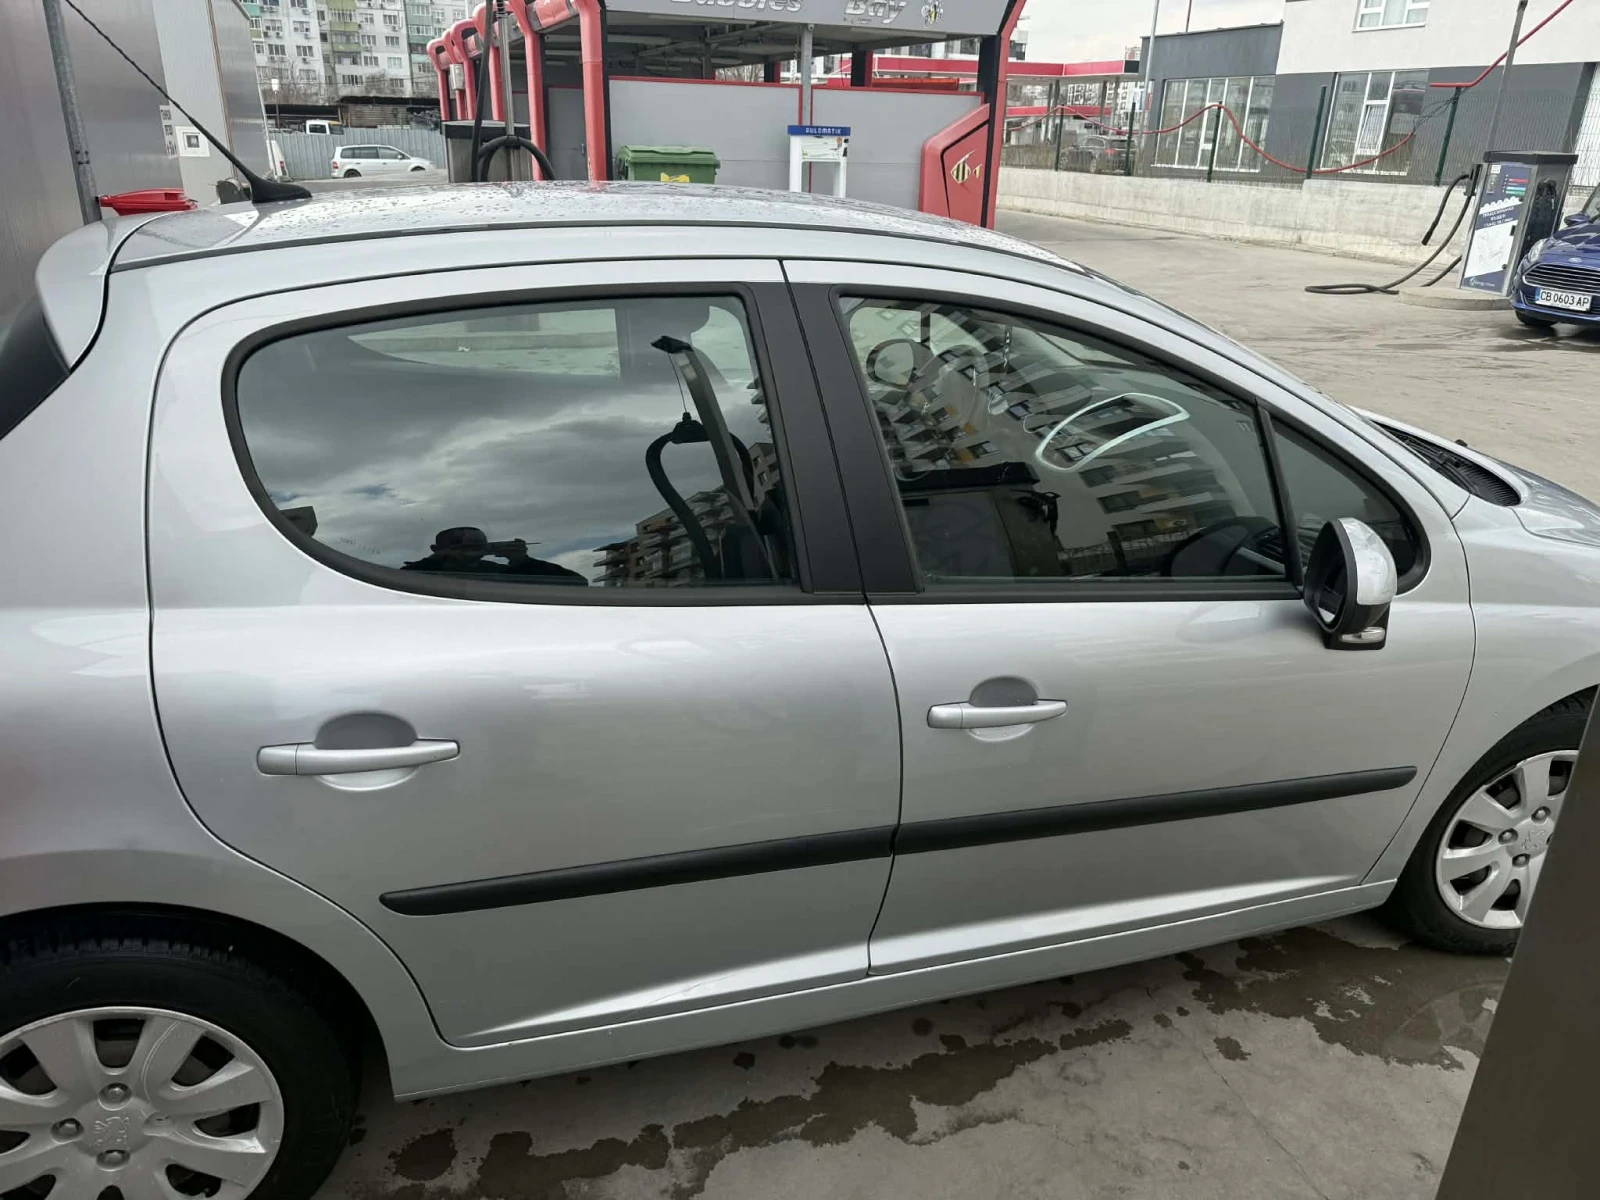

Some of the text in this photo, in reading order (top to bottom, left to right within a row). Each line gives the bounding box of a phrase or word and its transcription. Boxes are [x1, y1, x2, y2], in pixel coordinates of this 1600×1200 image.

[844, 0, 907, 24] Bay
[1540, 291, 1552, 302] CB
[1553, 293, 1575, 305] 0603
[1576, 296, 1590, 307] AP
